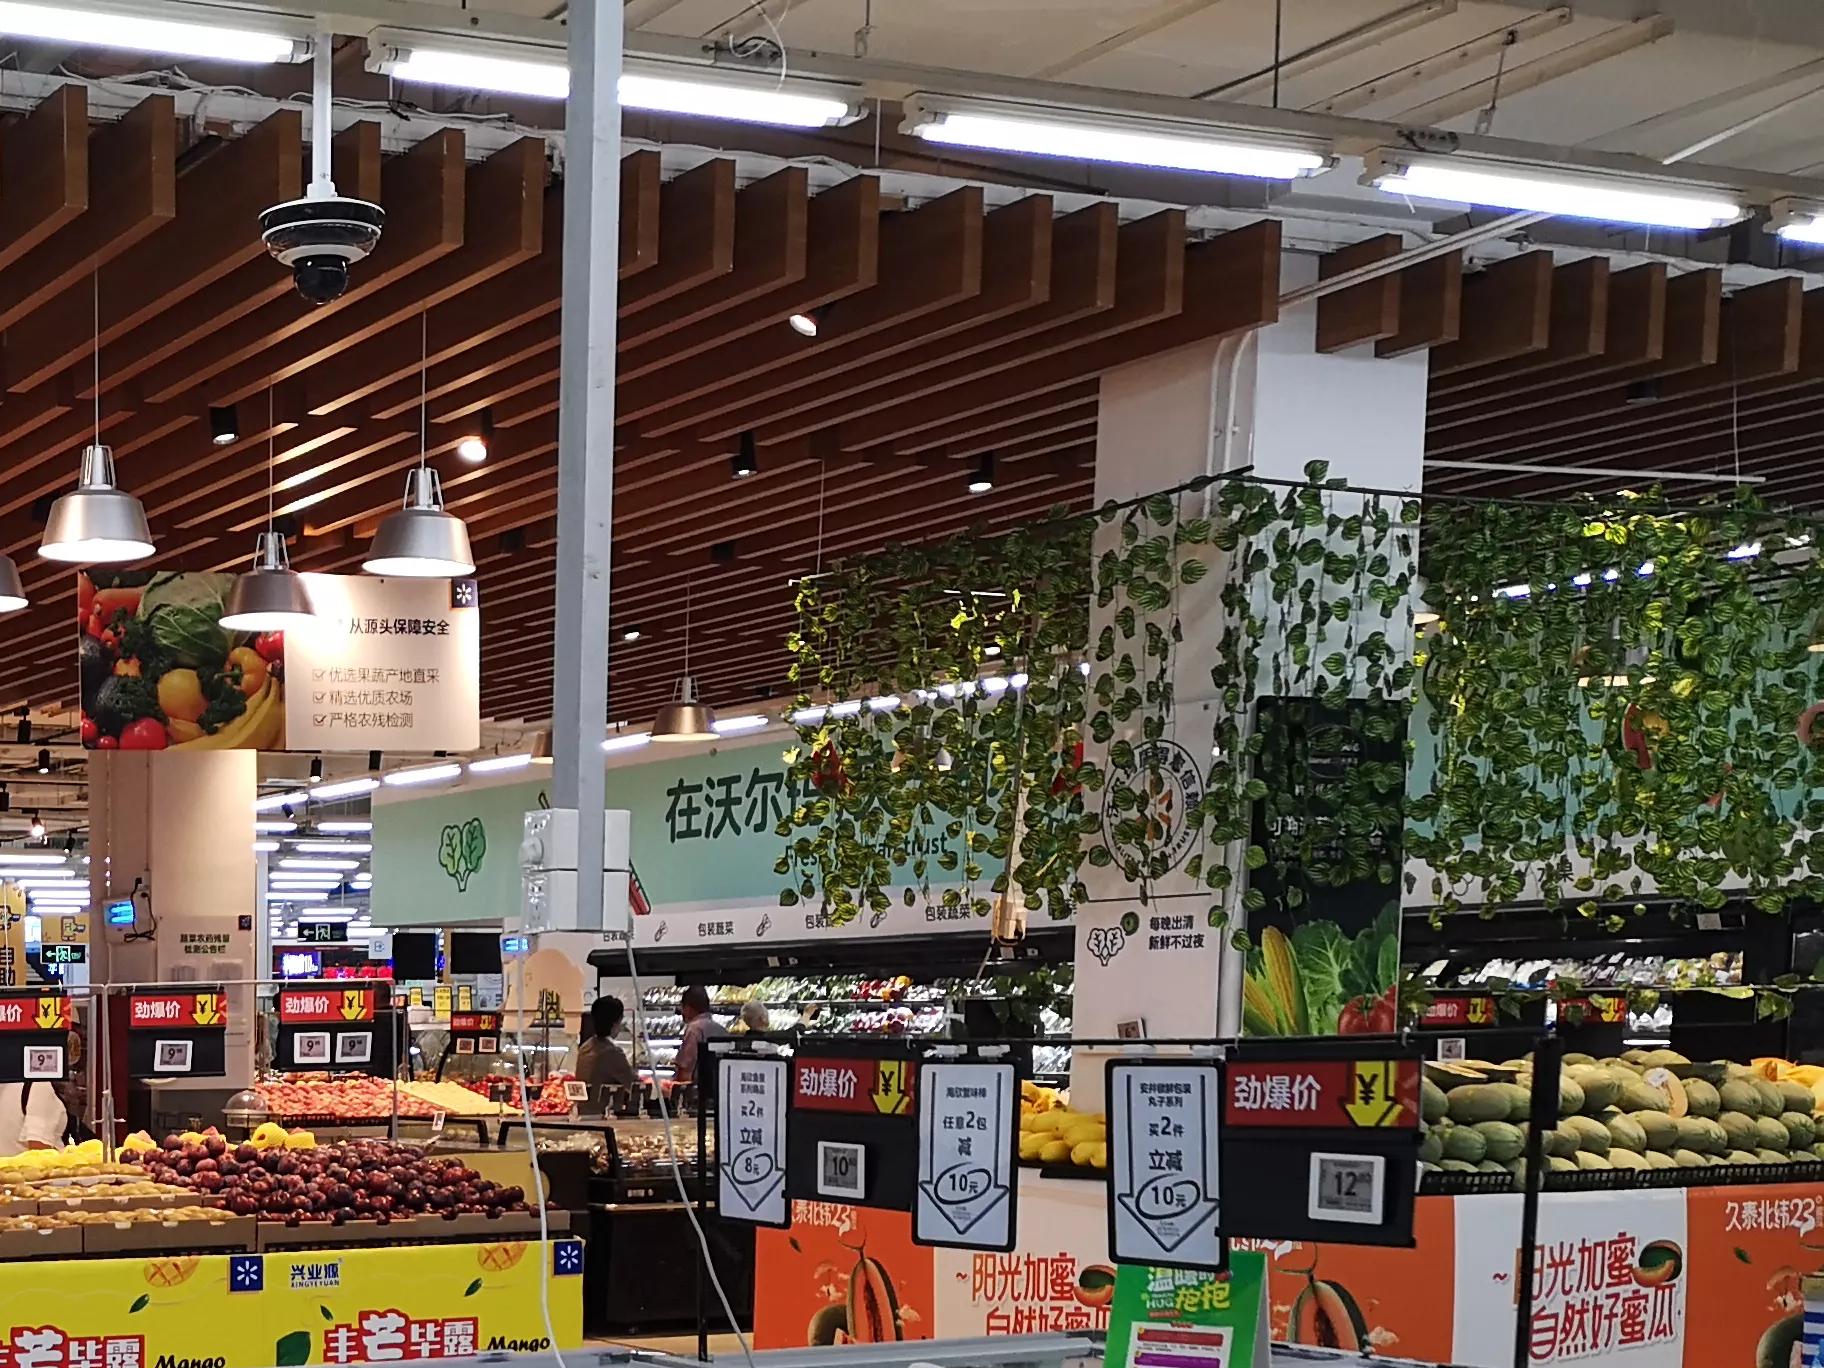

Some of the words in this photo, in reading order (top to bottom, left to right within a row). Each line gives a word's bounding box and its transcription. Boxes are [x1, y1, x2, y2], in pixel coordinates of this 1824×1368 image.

[349, 618, 450, 636] 从源头保障安全
[329, 668, 440, 685] 优选果蔬产地直采
[329, 690, 413, 706] 精选优质农场
[329, 712, 414, 729] 严格农残检测
[926, 904, 970, 922] 包装蔬菜
[698, 921, 734, 936] 包装蔬菜
[1149, 916, 1194, 931] 每晚出清
[1149, 934, 1204, 951] 新鲜不过夜
[134, 1002, 180, 1019] 劲爆价
[285, 996, 329, 1014] 劲爆价
[800, 1068, 858, 1099] 劲爆价
[1234, 1075, 1322, 1111] 劲爆价
[1149, 1116, 1184, 1138] 买2件
[740, 1128, 763, 1146] 立减
[1149, 1149, 1183, 1171] 立减
[949, 1174, 978, 1195] 10元
[1151, 1185, 1186, 1208] 10元
[291, 1262, 340, 1280] 兴业源
[972, 1252, 1076, 1302] 阳光加蜜
[1528, 1283, 1677, 1360] 自然好蜜瓜
[326, 1314, 473, 1363] 丰芒毕露
[487, 1336, 551, 1352] Mango
